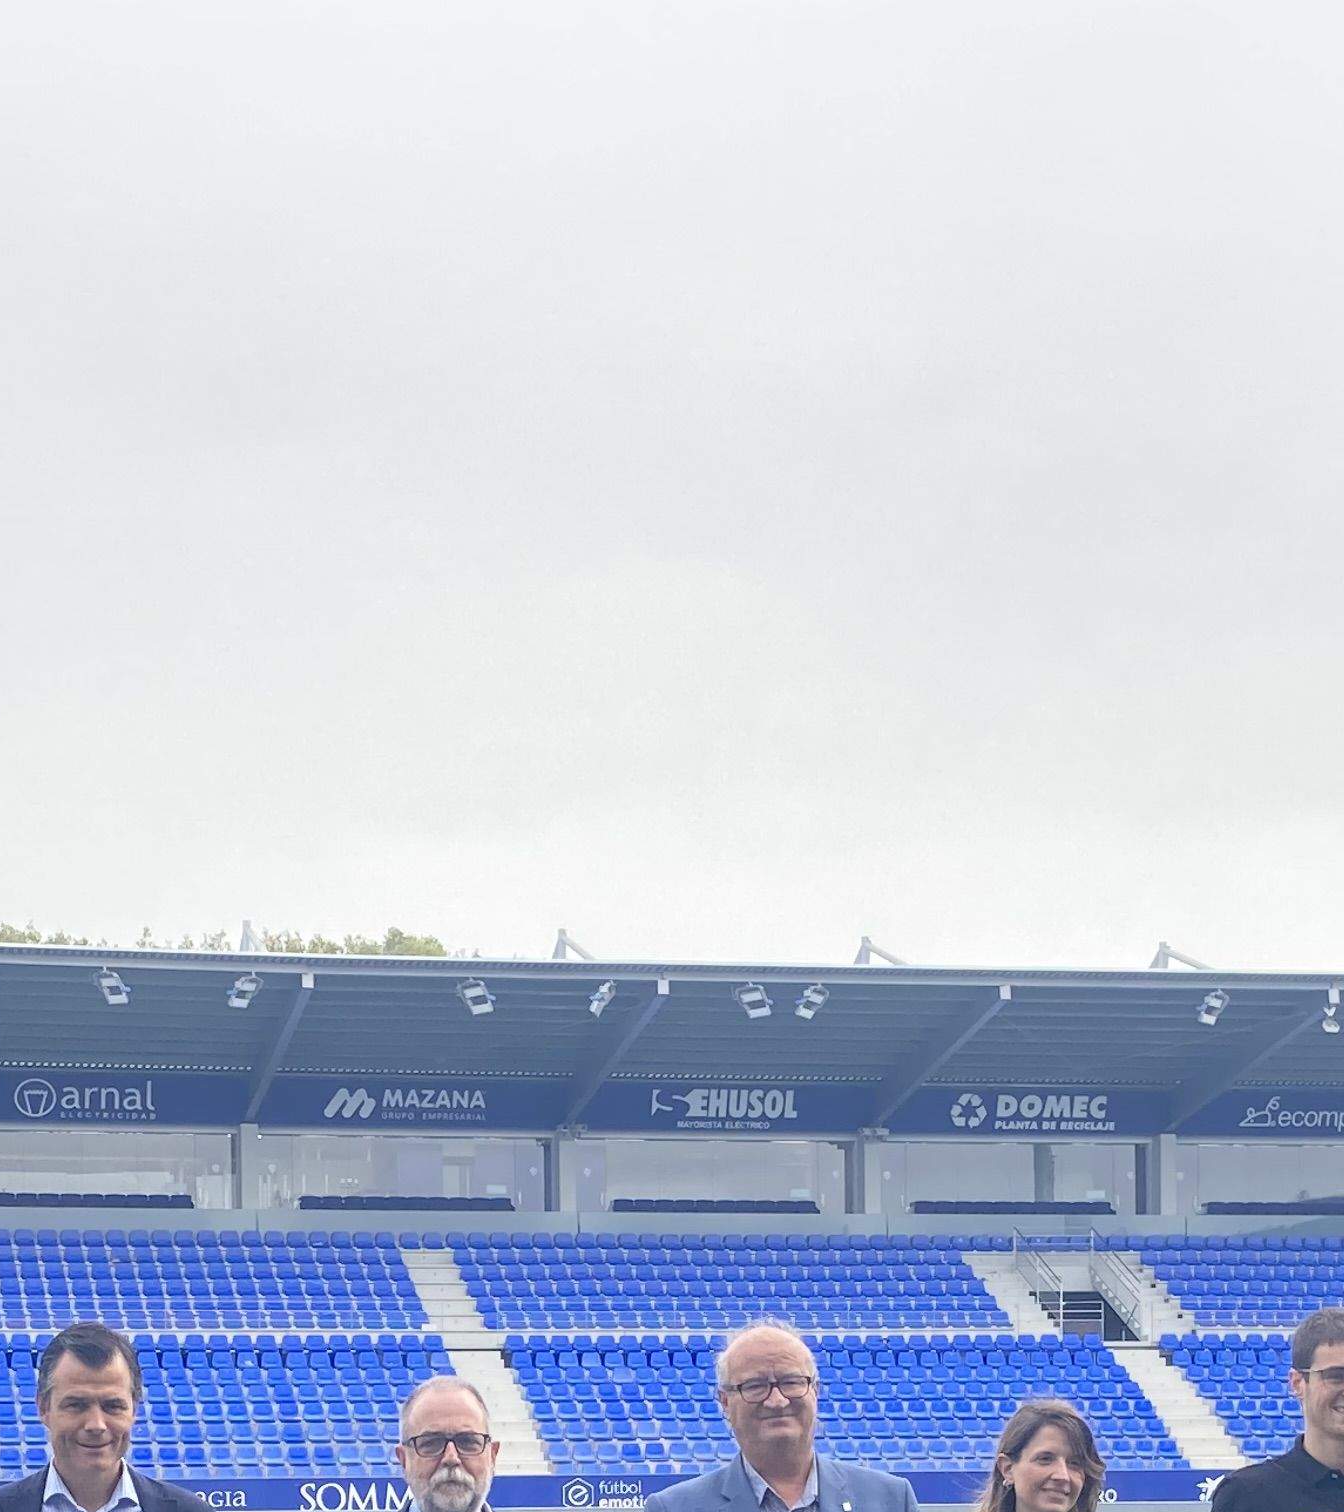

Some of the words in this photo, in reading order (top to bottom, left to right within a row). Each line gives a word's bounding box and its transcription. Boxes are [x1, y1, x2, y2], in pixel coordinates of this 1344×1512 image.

[61, 1080, 155, 1110] arnal
[382, 1089, 485, 1108] MAZANA
[685, 1089, 797, 1118] EHUSOL
[997, 1094, 1107, 1118] DOMEC
[381, 1111, 414, 1120] GRUPO
[422, 1112, 487, 1121] EMPRESARIAL
[995, 1121, 1038, 1130] PLANTA
[1042, 1121, 1056, 1130] DE
[1060, 1121, 1115, 1131] RECICLAJE
[599, 1479, 642, 1494] fútbol
